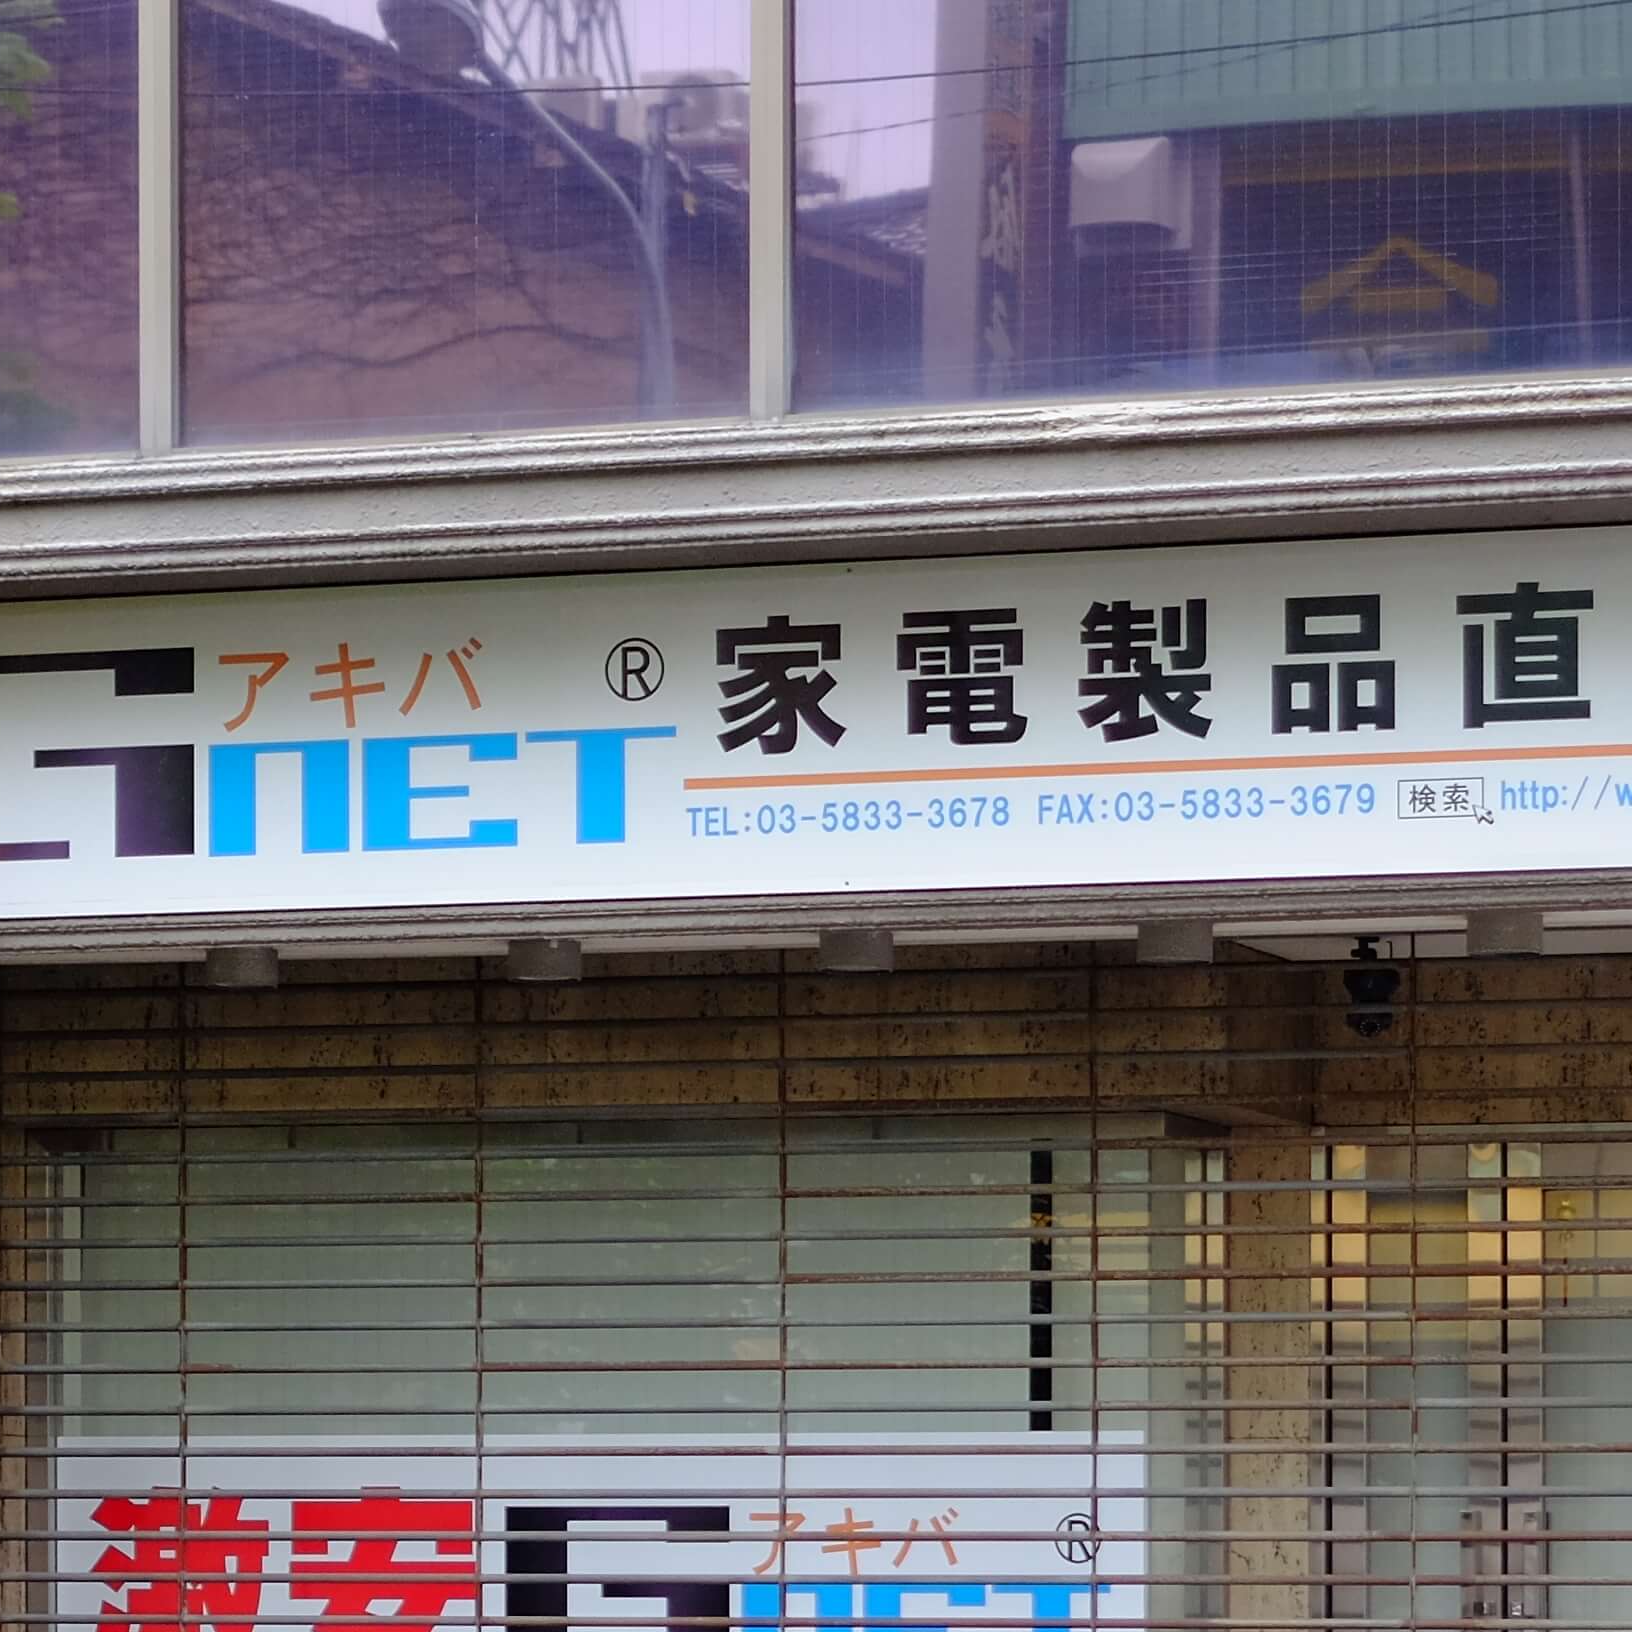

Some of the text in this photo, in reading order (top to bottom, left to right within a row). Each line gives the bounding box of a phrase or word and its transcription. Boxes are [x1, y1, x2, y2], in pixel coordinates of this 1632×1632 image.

[218, 635, 484, 734] アキバ
[685, 781, 1376, 839] TEL:03-5833-3678 FAX:03-5833-3679
[1408, 783, 1470, 815] 検索
[747, 1507, 959, 1575] アキバ
